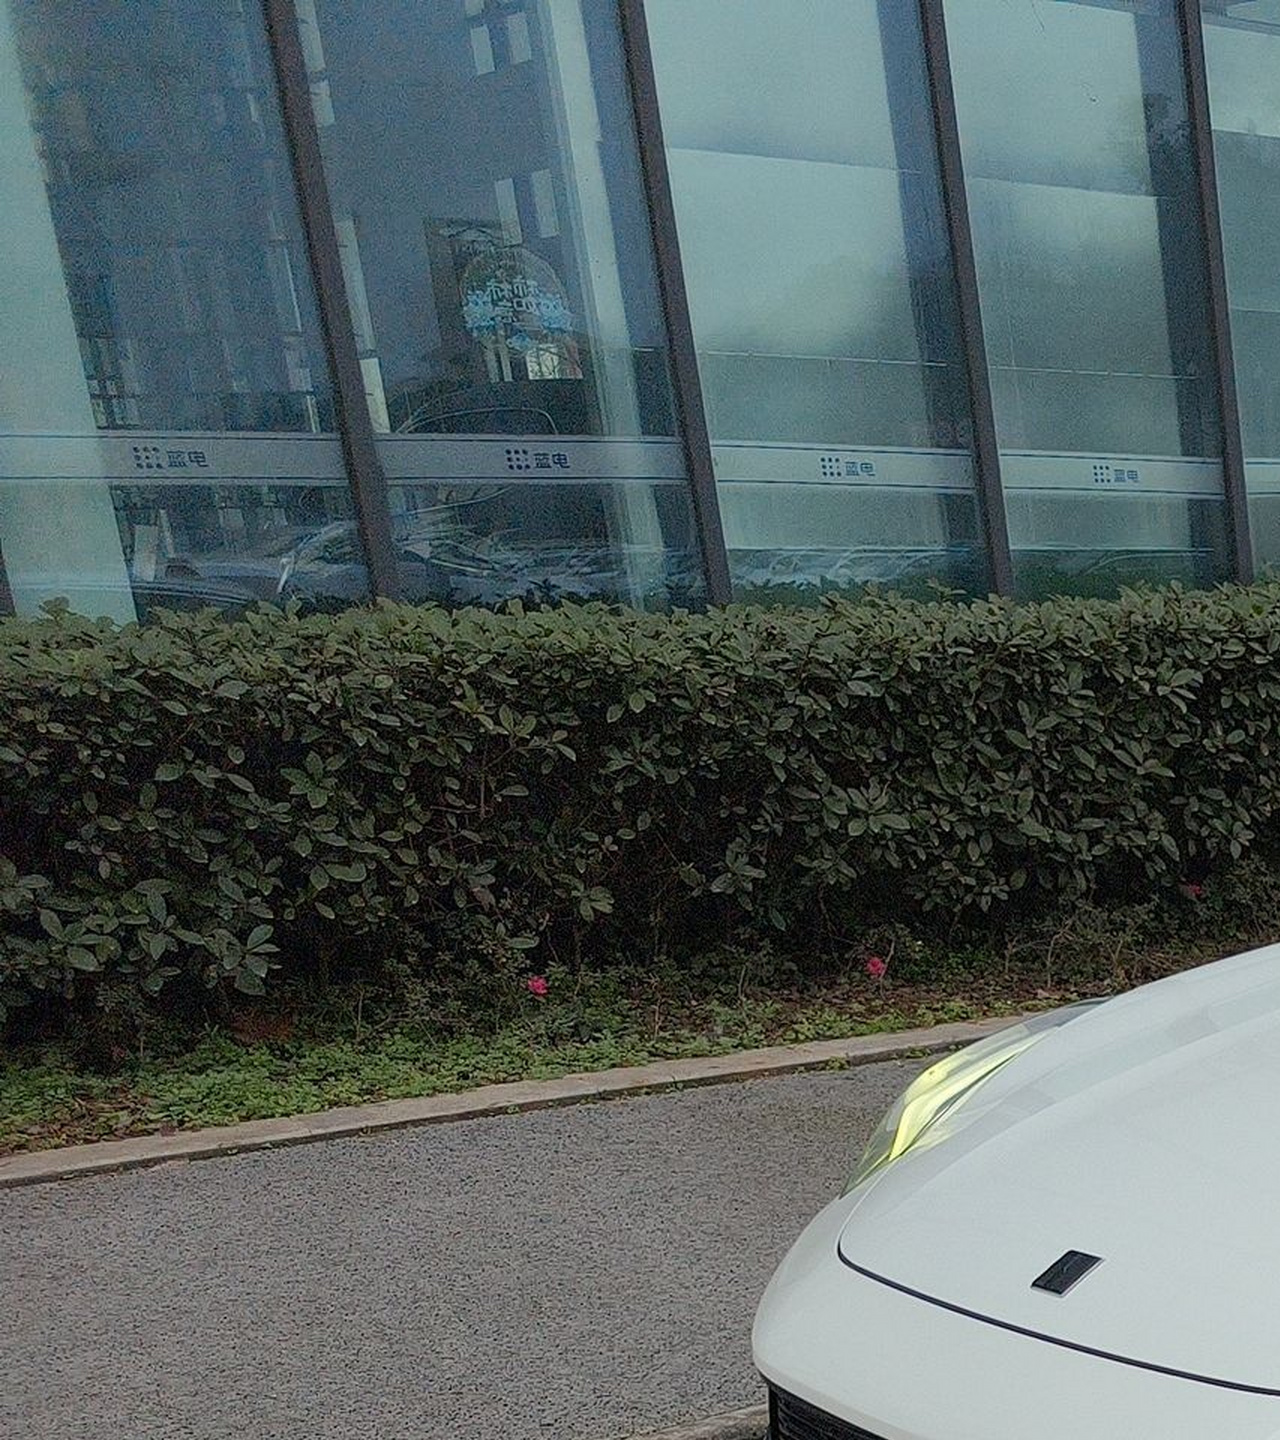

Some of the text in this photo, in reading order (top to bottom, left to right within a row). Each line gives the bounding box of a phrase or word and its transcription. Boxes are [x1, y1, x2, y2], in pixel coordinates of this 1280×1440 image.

[166, 450, 209, 468] 蓝电
[533, 451, 571, 469] 蓝电
[844, 461, 876, 477] 蓝电
